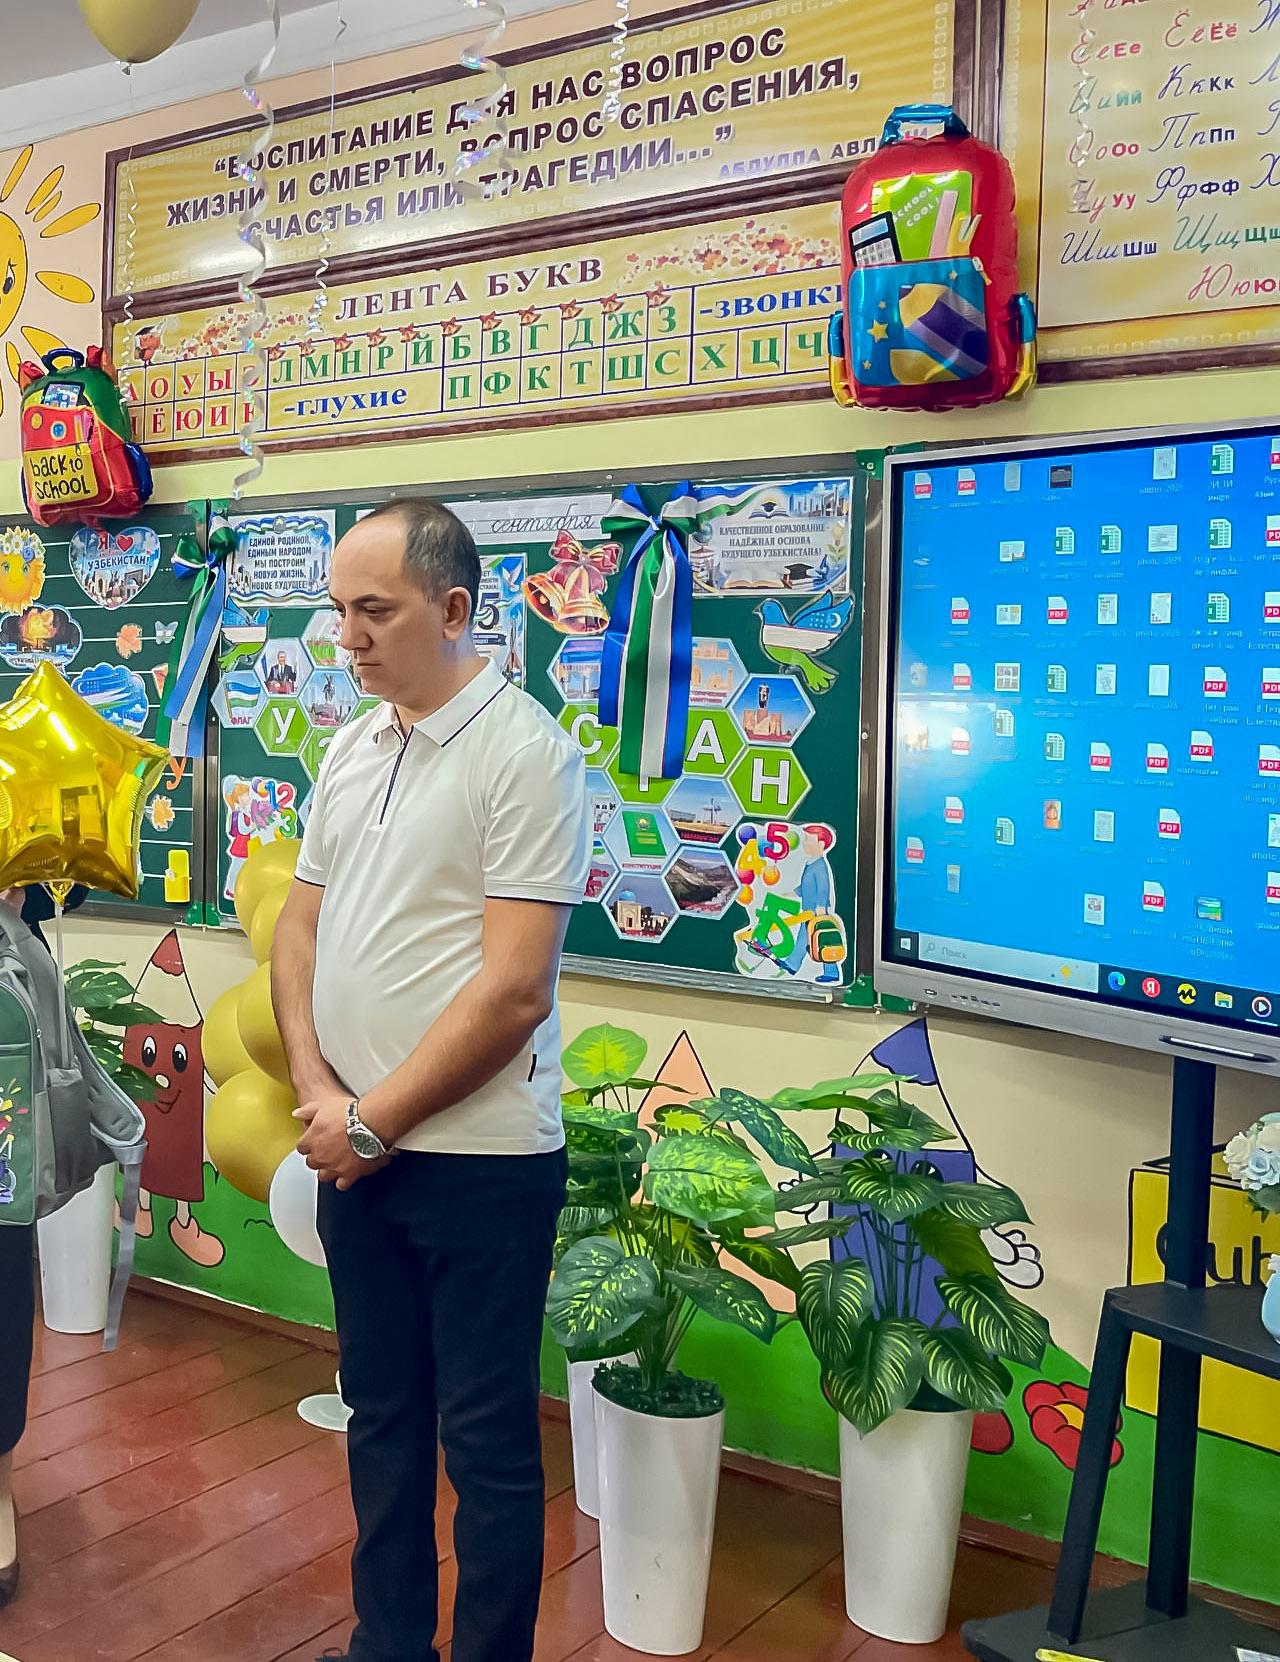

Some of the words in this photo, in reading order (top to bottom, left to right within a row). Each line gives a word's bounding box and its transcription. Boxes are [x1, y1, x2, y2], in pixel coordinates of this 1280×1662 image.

[531, 70, 603, 110] НАС
[621, 28, 784, 89] ВОПРОС
[167, 187, 265, 226] ЖИЗНИ
[278, 178, 296, 203] И
[309, 148, 444, 196] СМЕРТИ,
[620, 58, 859, 130] СПАСЕНИЯ,
[248, 196, 383, 241] СЧАСТЬЯ
[397, 181, 463, 216] ИЛИ
[335, 281, 469, 321] ЛЕНТА
[487, 258, 603, 298] БУКВ
[150, 377, 169, 399] О
[181, 372, 200, 395] У
[207, 368, 233, 392] Ы
[273, 359, 293, 384] Л
[304, 355, 329, 380] М
[342, 350, 361, 374] Н
[376, 345, 394, 370] Р
[412, 334, 434, 365] Й
[452, 335, 471, 360] Б
[490, 330, 511, 355] В
[527, 323, 549, 350] Г
[568, 318, 594, 350] Д
[607, 310, 644, 340] Ж
[658, 306, 677, 333] З
[152, 407, 166, 434] Ё
[175, 408, 203, 431] Ю
[209, 405, 228, 427] И
[284, 387, 408, 419] -глухие
[447, 375, 472, 400] П
[484, 371, 511, 395] Ф
[527, 366, 551, 391] К
[571, 361, 593, 385] Т
[607, 354, 643, 381] Ш
[654, 351, 681, 375] С
[700, 344, 727, 371] Х
[751, 338, 780, 368] Ц
[797, 331, 822, 357] Ч
[70, 457, 83, 473] to
[88, 555, 150, 571] УЗБЕКИСТАН!
[1206, 683, 1224, 691] PDF
[231, 717, 253, 725] ФЛАГ
[271, 707, 296, 744] У
[571, 713, 604, 755] С
[686, 718, 726, 764] А
[1192, 747, 1210, 755] PDF
[1092, 757, 1109, 766] PDF
[1148, 758, 1165, 768] PDF
[1261, 761, 1280, 770] PDF
[751, 758, 791, 804] Н
[1160, 823, 1177, 832] PDF
[1145, 896, 1161, 905] PDF
